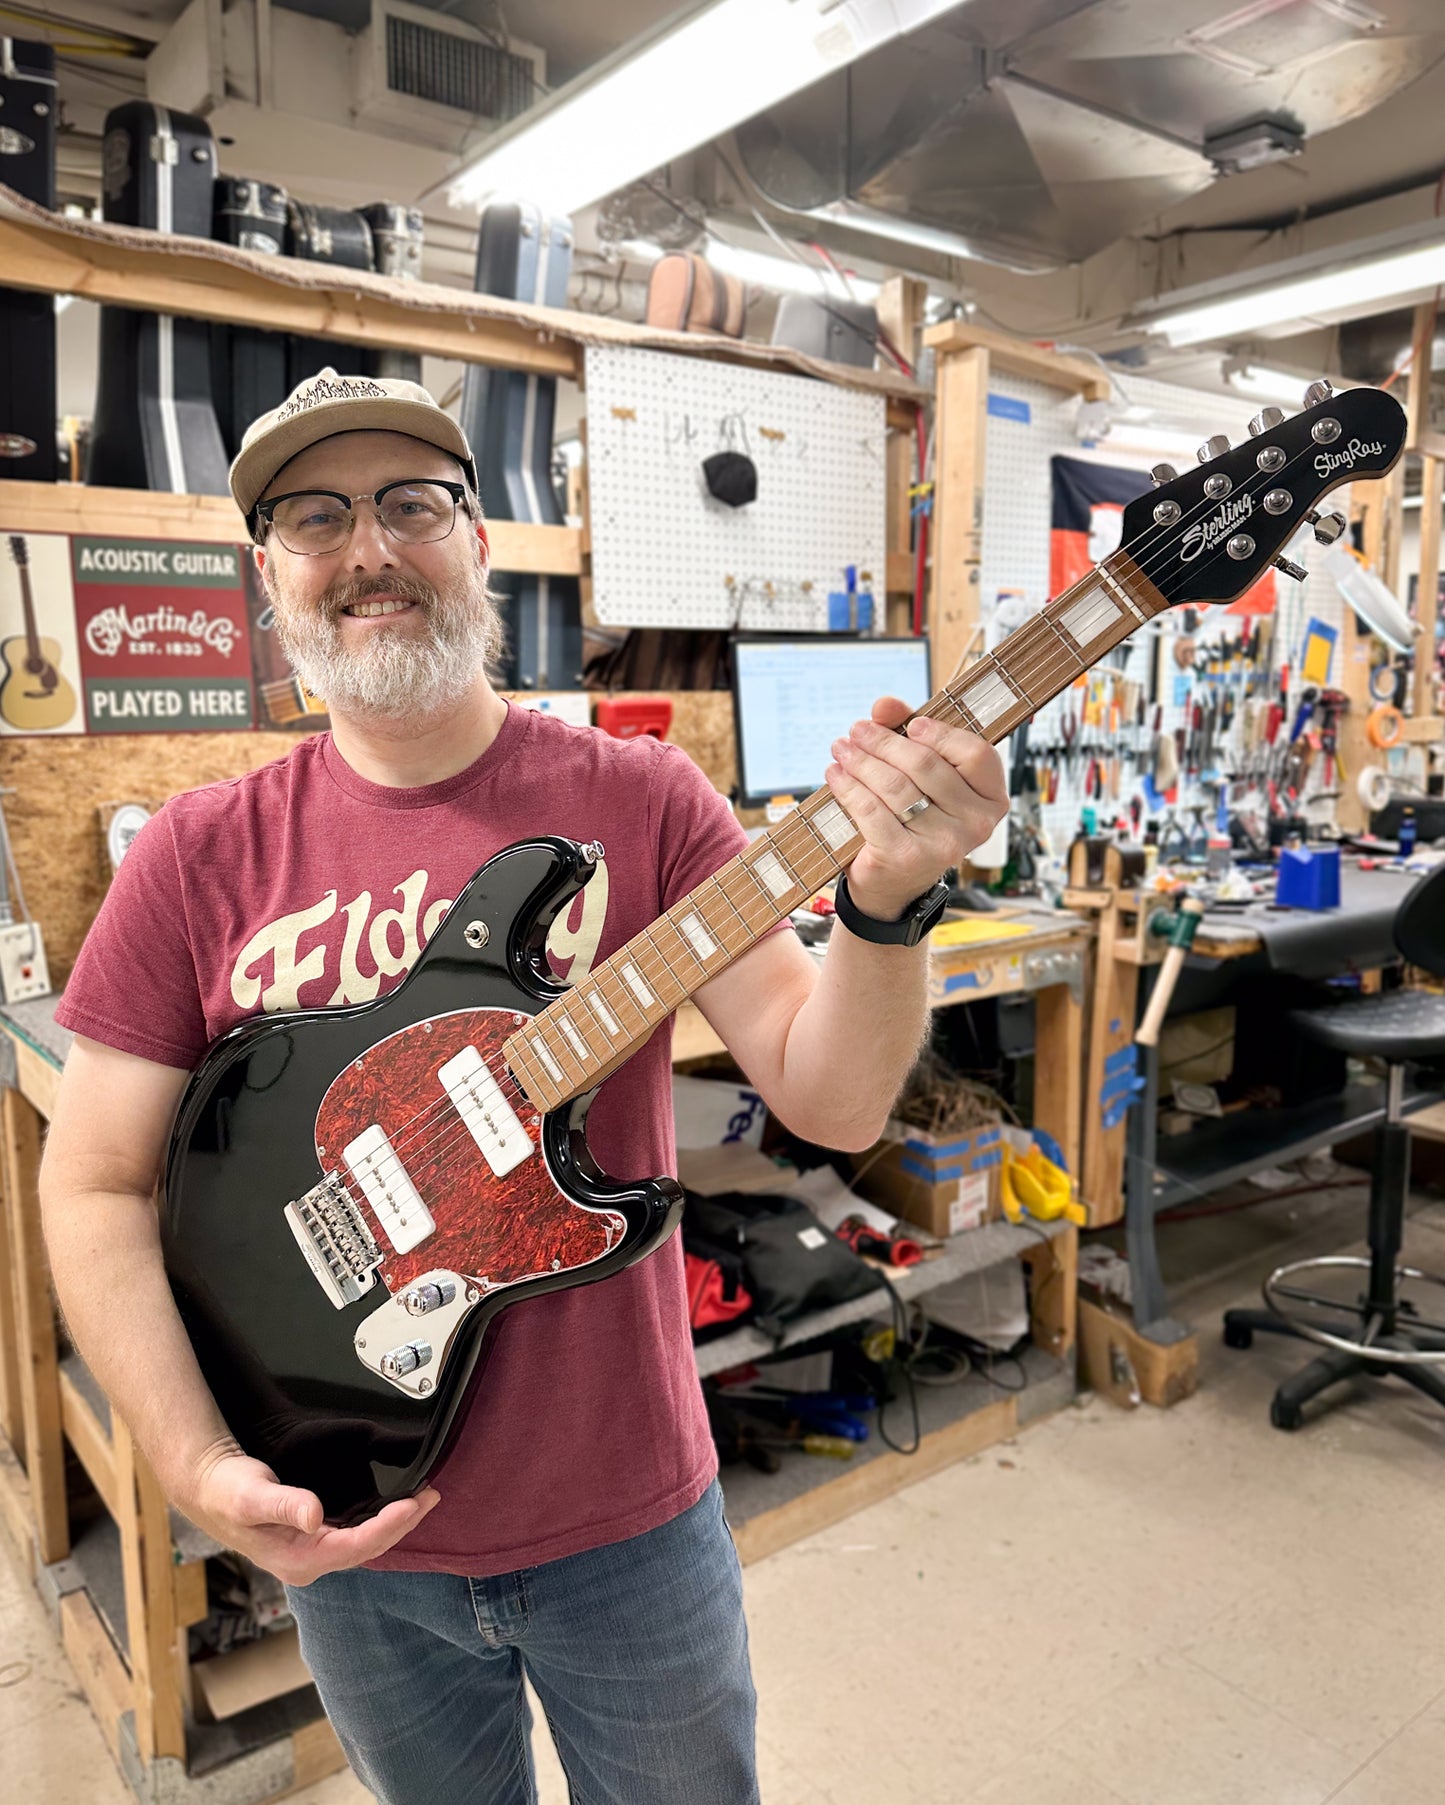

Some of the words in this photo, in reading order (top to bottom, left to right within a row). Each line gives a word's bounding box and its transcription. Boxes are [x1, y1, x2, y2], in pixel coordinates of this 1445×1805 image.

[1314, 438, 1383, 478] StingRay
[1180, 493, 1253, 562] Sterling
[80, 547, 169, 574] ACOUSTIC
[172, 552, 236, 577] GUITAR
[92, 689, 183, 718] PLAYED
[188, 689, 248, 716] HERE
